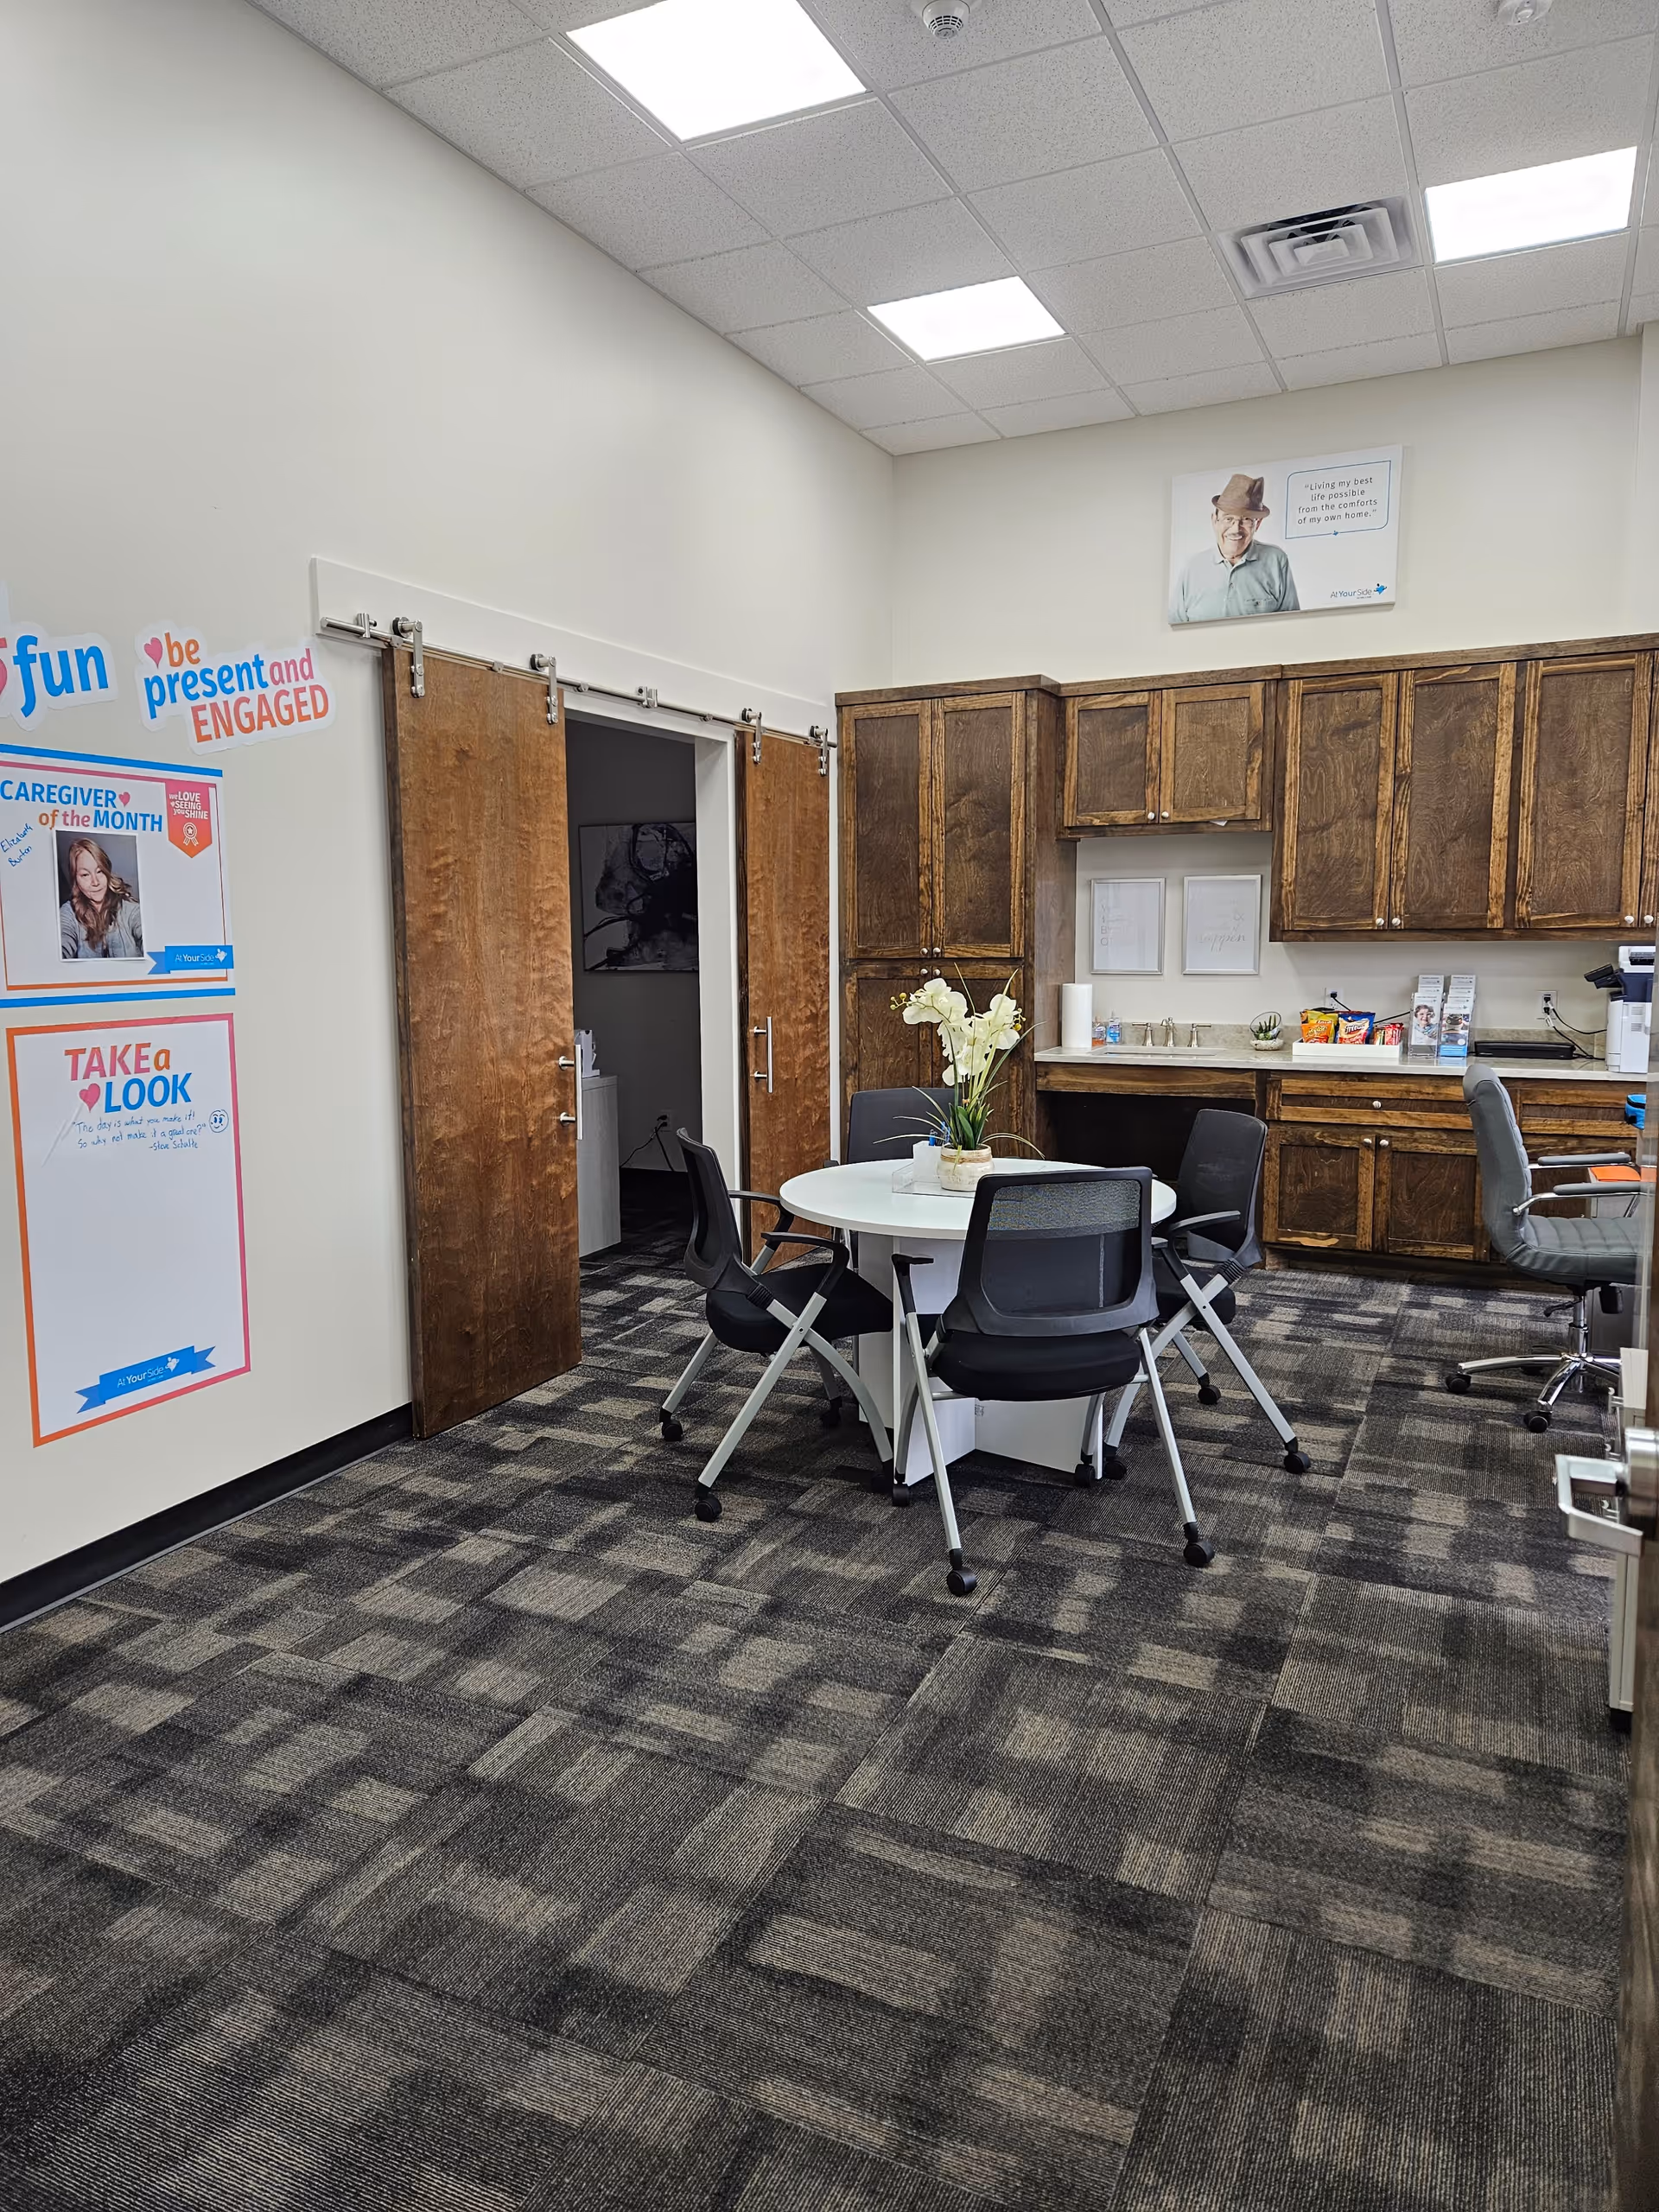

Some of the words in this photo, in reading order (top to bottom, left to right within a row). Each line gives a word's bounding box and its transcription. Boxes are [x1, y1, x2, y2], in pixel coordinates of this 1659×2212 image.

[1338, 480, 1351, 488] my
[1354, 477, 1372, 486] best
[1328, 489, 1365, 500] possible
[1338, 499, 1377, 509] comforts
[164, 632, 200, 667] be
[12, 634, 109, 718] fun
[143, 653, 269, 720] present
[269, 648, 314, 686] and
[191, 684, 329, 743] ENGAGED
[0, 779, 117, 809] CAREGIVER
[175, 800, 201, 810] SEEING
[178, 791, 200, 802] LOVE
[38, 809, 60, 830] of
[62, 810, 91, 827] the
[92, 810, 162, 832] MONTH
[184, 809, 208, 820] SHINE
[200, 953, 214, 962] Side
[64, 1042, 151, 1081] TAKE
[154, 1048, 170, 1071] a
[104, 1072, 192, 1113] LOOK
[97, 1116, 111, 1131] day
[124, 1116, 143, 1125] what
[162, 1113, 181, 1122] make
[184, 1109, 194, 1121] it!
[78, 1138, 87, 1149] So
[91, 1135, 106, 1146] why
[112, 1130, 123, 1142] not
[127, 1128, 147, 1140] make
[151, 1128, 156, 1138] it
[168, 1124, 184, 1141] great
[117, 1378, 126, 1388] At
[125, 1371, 147, 1384] Your
[147, 1365, 164, 1377] Side
